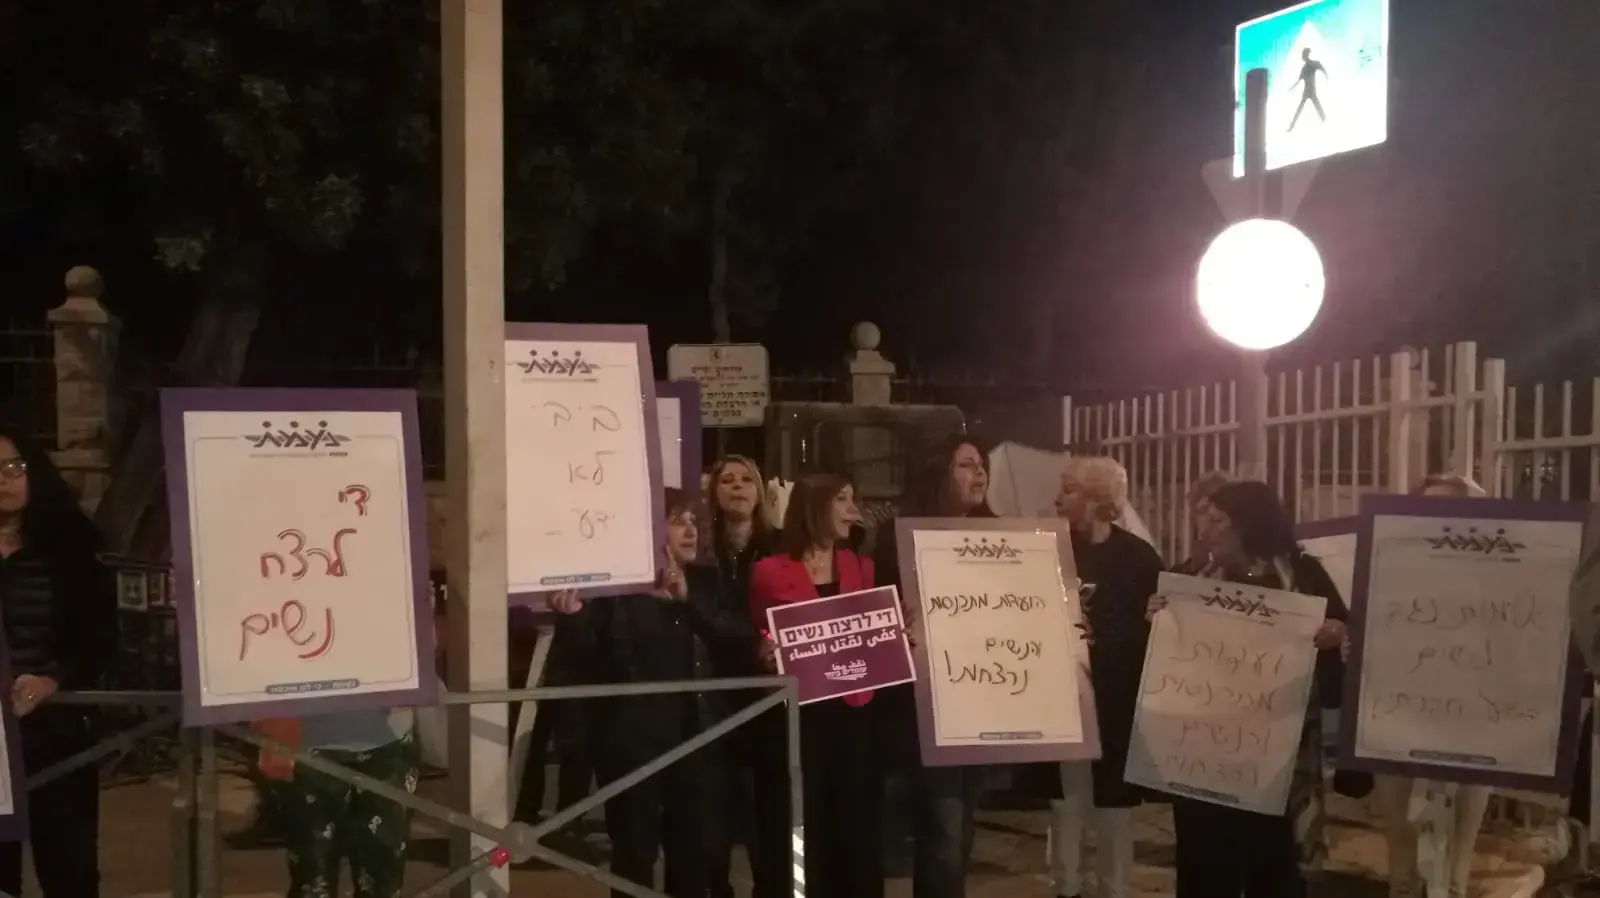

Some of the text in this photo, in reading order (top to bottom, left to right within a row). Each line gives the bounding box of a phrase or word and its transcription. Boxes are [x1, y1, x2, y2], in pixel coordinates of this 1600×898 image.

[531, 401, 621, 432] ביבי
[568, 449, 616, 486] לא
[338, 484, 371, 516] די
[261, 528, 357, 581] לרצח
[239, 600, 335, 661] נשים
[785, 611, 892, 643] די לרצח נשים
